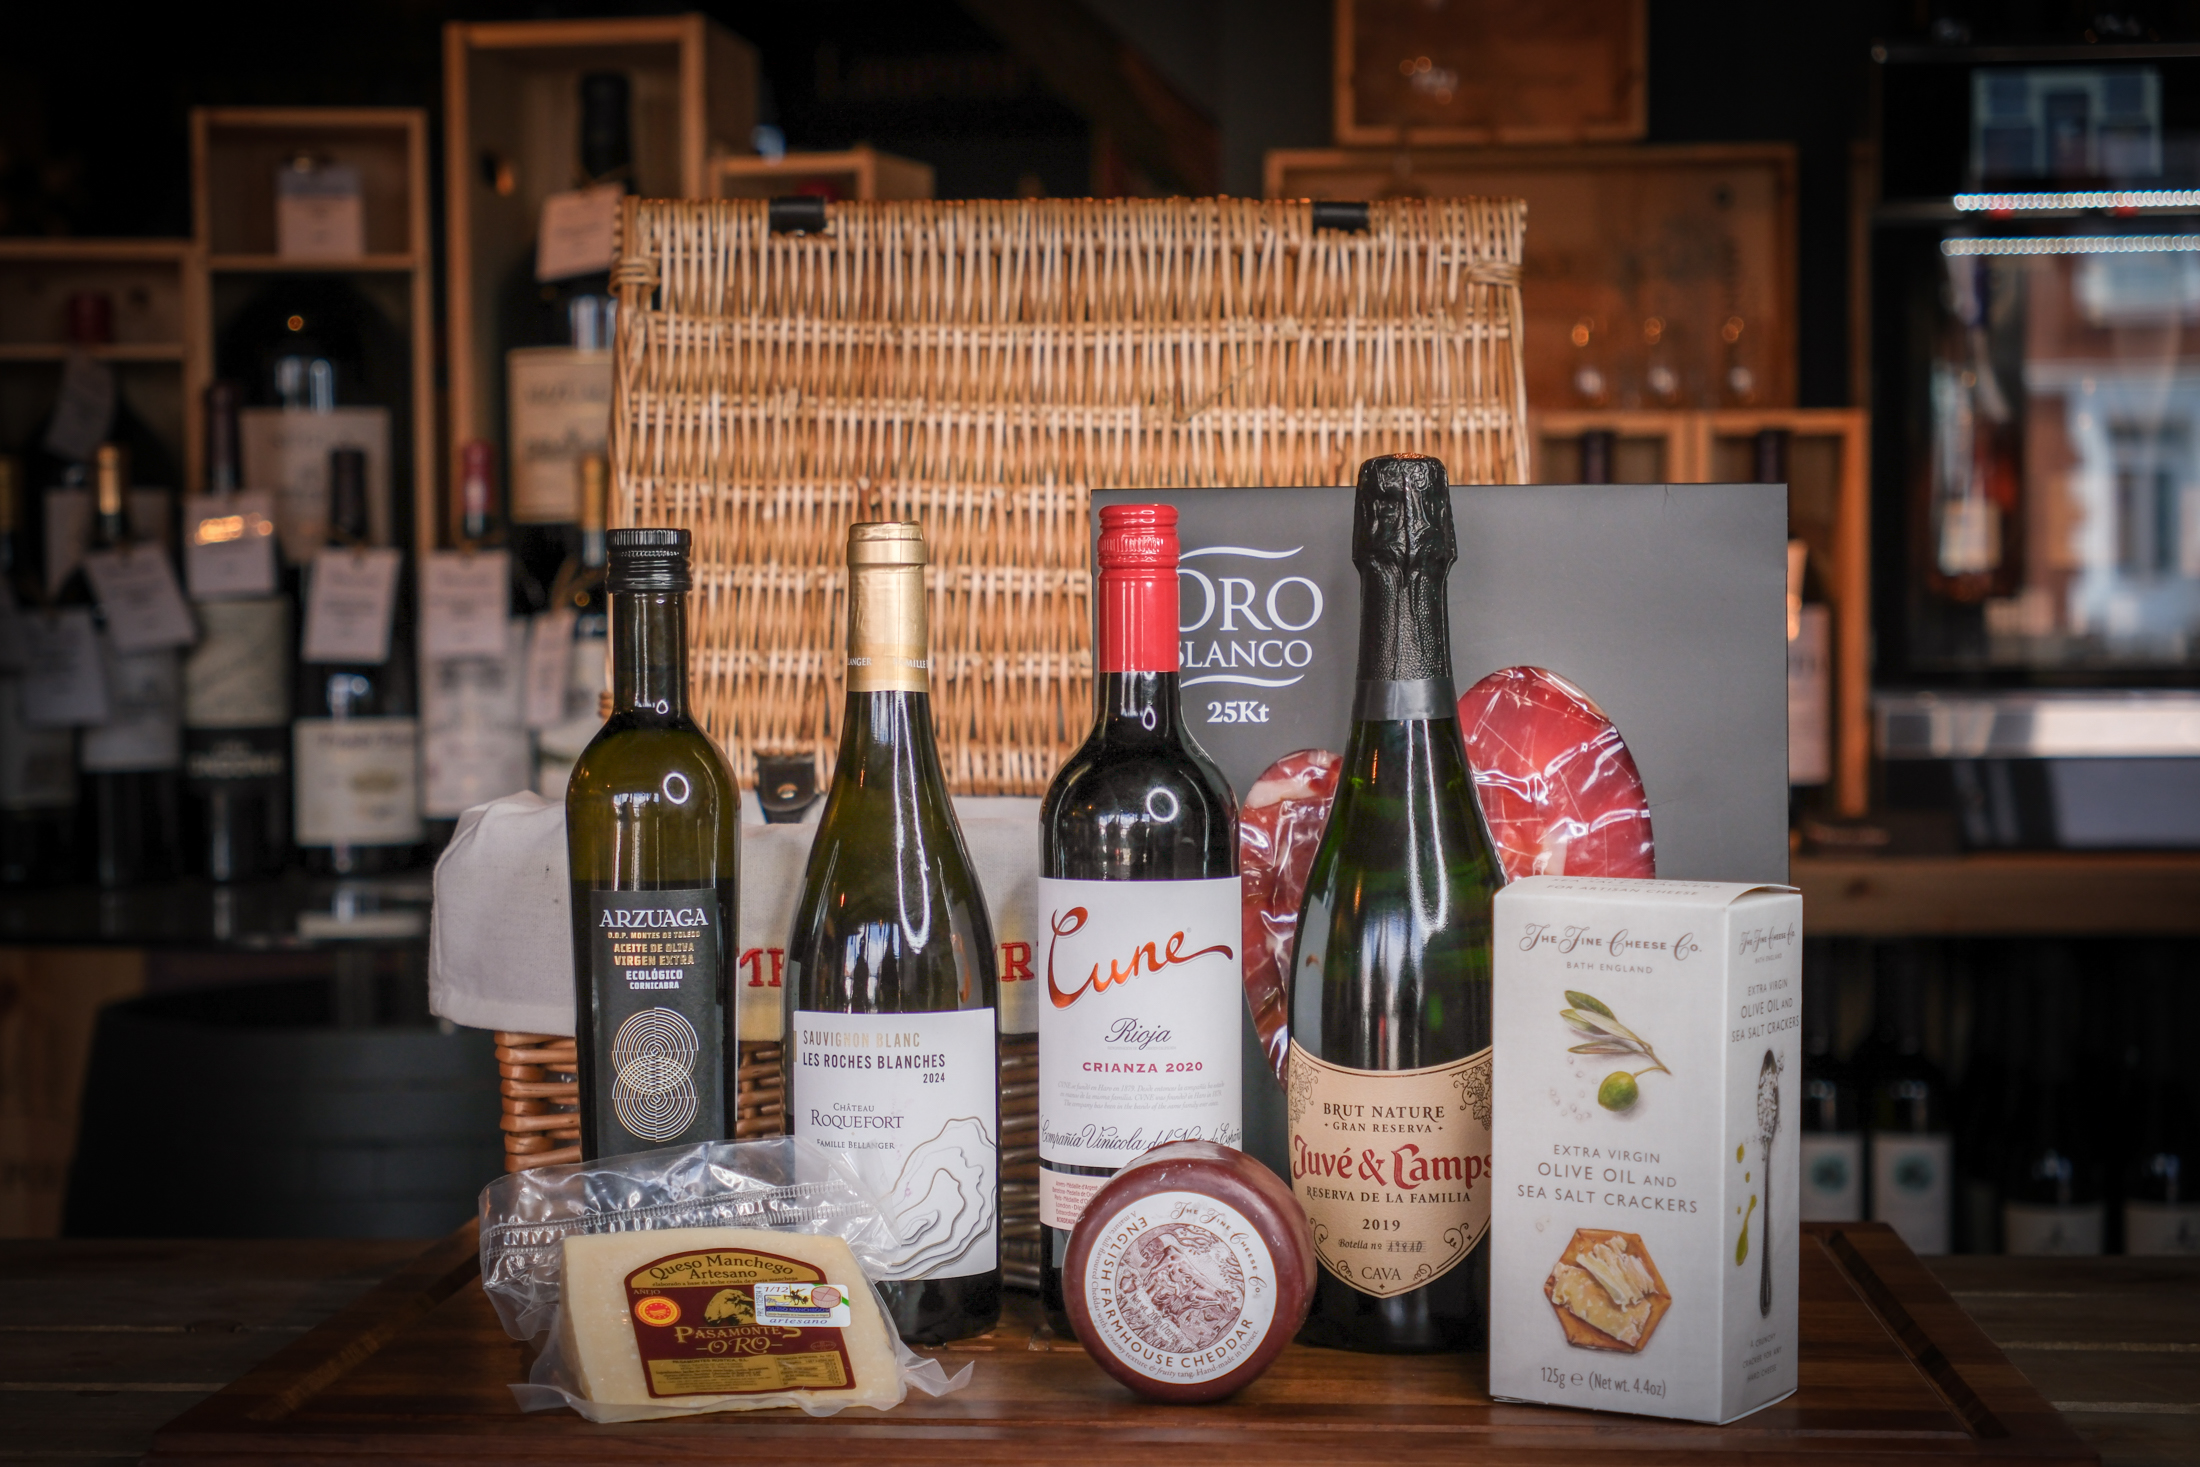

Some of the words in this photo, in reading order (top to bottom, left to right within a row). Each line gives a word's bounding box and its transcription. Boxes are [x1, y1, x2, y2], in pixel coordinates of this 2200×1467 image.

[1179, 640, 1312, 668] LANCO
[1207, 701, 1270, 723] 25Kt
[599, 908, 709, 928] ARZUAGA
[662, 931, 671, 939] DE
[614, 943, 647, 953] ACEITE
[650, 943, 663, 952] DE
[666, 943, 694, 952] OLIVA
[614, 955, 656, 966] VIRGEN
[659, 955, 694, 965] EXTRA
[1048, 906, 1233, 1009] Cune
[626, 968, 683, 980] ECOLÓGICO
[1567, 962, 1594, 970] BATH
[1600, 963, 1653, 974] ENGLAND
[630, 981, 679, 990] CORNICABRA
[1748, 984, 1767, 996] EXTRA
[1769, 979, 1788, 991] VIRGIN
[1741, 1002, 1764, 1018] OLIVE
[1767, 999, 1779, 1013] OIL
[1782, 998, 1792, 1008] AND
[1104, 1018, 1172, 1050] Rioja
[1732, 1030, 1745, 1042] SEA
[1748, 1024, 1764, 1039] SALT
[1768, 1015, 1799, 1034] CRACKERS
[803, 1030, 869, 1047] SAUVIGNON
[876, 1033, 920, 1048] BLANC
[803, 1052, 820, 1067] LES
[824, 1054, 871, 1069] ROCHES
[877, 1054, 945, 1069] BLANCHES
[1082, 1062, 1158, 1073] CRIANZA
[1166, 1061, 1203, 1073] 2020
[923, 1073, 945, 1083] 2024
[833, 1102, 875, 1112] CHÂTEAU
[1323, 1103, 1364, 1121] BRUT
[1372, 1106, 1445, 1122] NATURE
[811, 1109, 904, 1129] ROQUEFORT
[1333, 1121, 1366, 1132] GRAN
[1372, 1124, 1432, 1133] RESERVA
[817, 1139, 845, 1149] FAMILLE
[848, 1141, 895, 1149] BELLANGER
[1082, 1123, 1147, 1150] Vinícola
[1293, 1134, 1353, 1180] Juvé
[1358, 1149, 1387, 1186] &
[1554, 1144, 1601, 1159] EXTRA
[1608, 1149, 1660, 1163] VIRGIN
[1538, 1162, 1593, 1180] OLIVE
[1603, 1168, 1635, 1184] OIL
[1644, 1175, 1677, 1188] AND
[1307, 1186, 1355, 1201] RESERVA
[1361, 1192, 1380, 1203] DE
[1386, 1193, 1404, 1203] LA
[1410, 1192, 1471, 1203] FAMILIA
[1518, 1185, 1547, 1200] SEA
[1555, 1188, 1596, 1204] SALT
[1604, 1193, 1697, 1214] CRACKERS
[1362, 1219, 1400, 1231] 2019
[1100, 1215, 1148, 1279] ENGLISH
[1338, 1239, 1368, 1249] Botella
[1091, 1233, 1113, 1278] full-flavoured
[649, 1259, 702, 1281] Queso
[706, 1254, 794, 1275] Manchego
[689, 1268, 757, 1280] Artesano
[1362, 1267, 1402, 1280] CAVA
[633, 1288, 661, 1296] AÑEJO
[1090, 1279, 1099, 1310] Cheddar
[1094, 1311, 1106, 1328] with
[1130, 1293, 1143, 1306] Net
[1138, 1302, 1150, 1315] wt.
[1146, 1309, 1165, 1329] 200g
[1158, 1321, 1177, 1341] (7oz)
[674, 1326, 802, 1344] PASAMONTES
[1099, 1287, 1172, 1369] FARMHOUSE
[707, 1336, 771, 1355] ORO
[1104, 1332, 1124, 1354] creamy
[1179, 1318, 1254, 1368] CHEDDAR
[1238, 1329, 1259, 1353] Dorset.
[1123, 1351, 1146, 1369] texture
[1232, 1350, 1241, 1359] in
[1146, 1364, 1154, 1373] &
[1153, 1367, 1174, 1379] fruity
[1194, 1355, 1235, 1376] Hand-made
[1541, 1366, 1565, 1389] 125g
[1589, 1371, 1612, 1391] (Net
[1615, 1378, 1630, 1393] wt.
[1633, 1378, 1666, 1399] 4.4oz)
